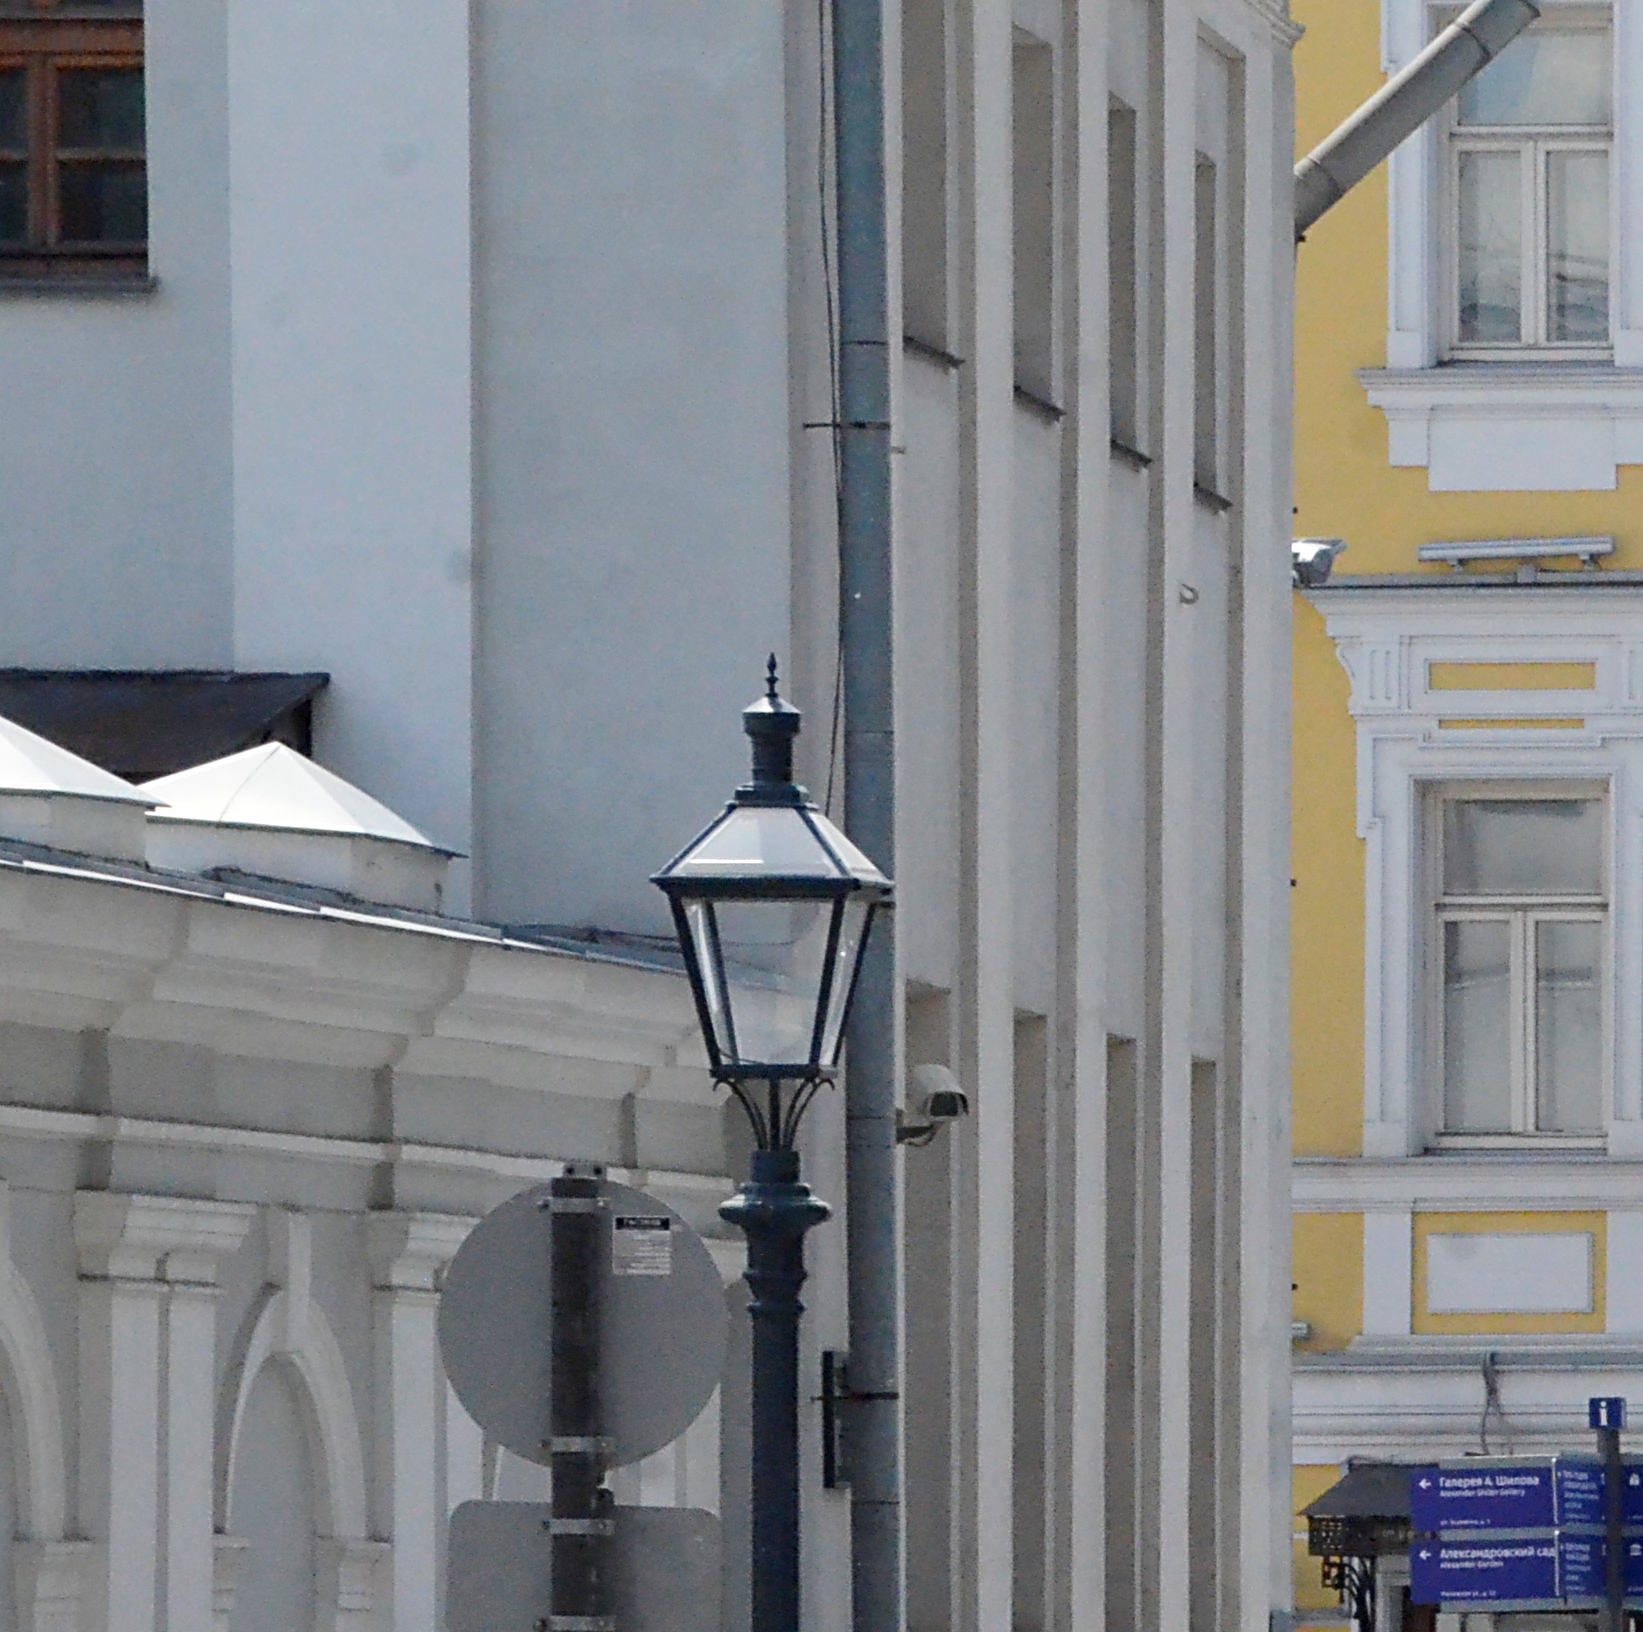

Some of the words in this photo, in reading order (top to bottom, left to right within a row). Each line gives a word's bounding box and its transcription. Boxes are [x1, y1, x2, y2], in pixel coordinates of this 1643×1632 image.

[1440, 1477, 1483, 1488] Галерея
[1495, 1475, 1540, 1486] Шилова
[1440, 1546, 1535, 1559] Александровский
[1536, 1547, 1556, 1558] сад
